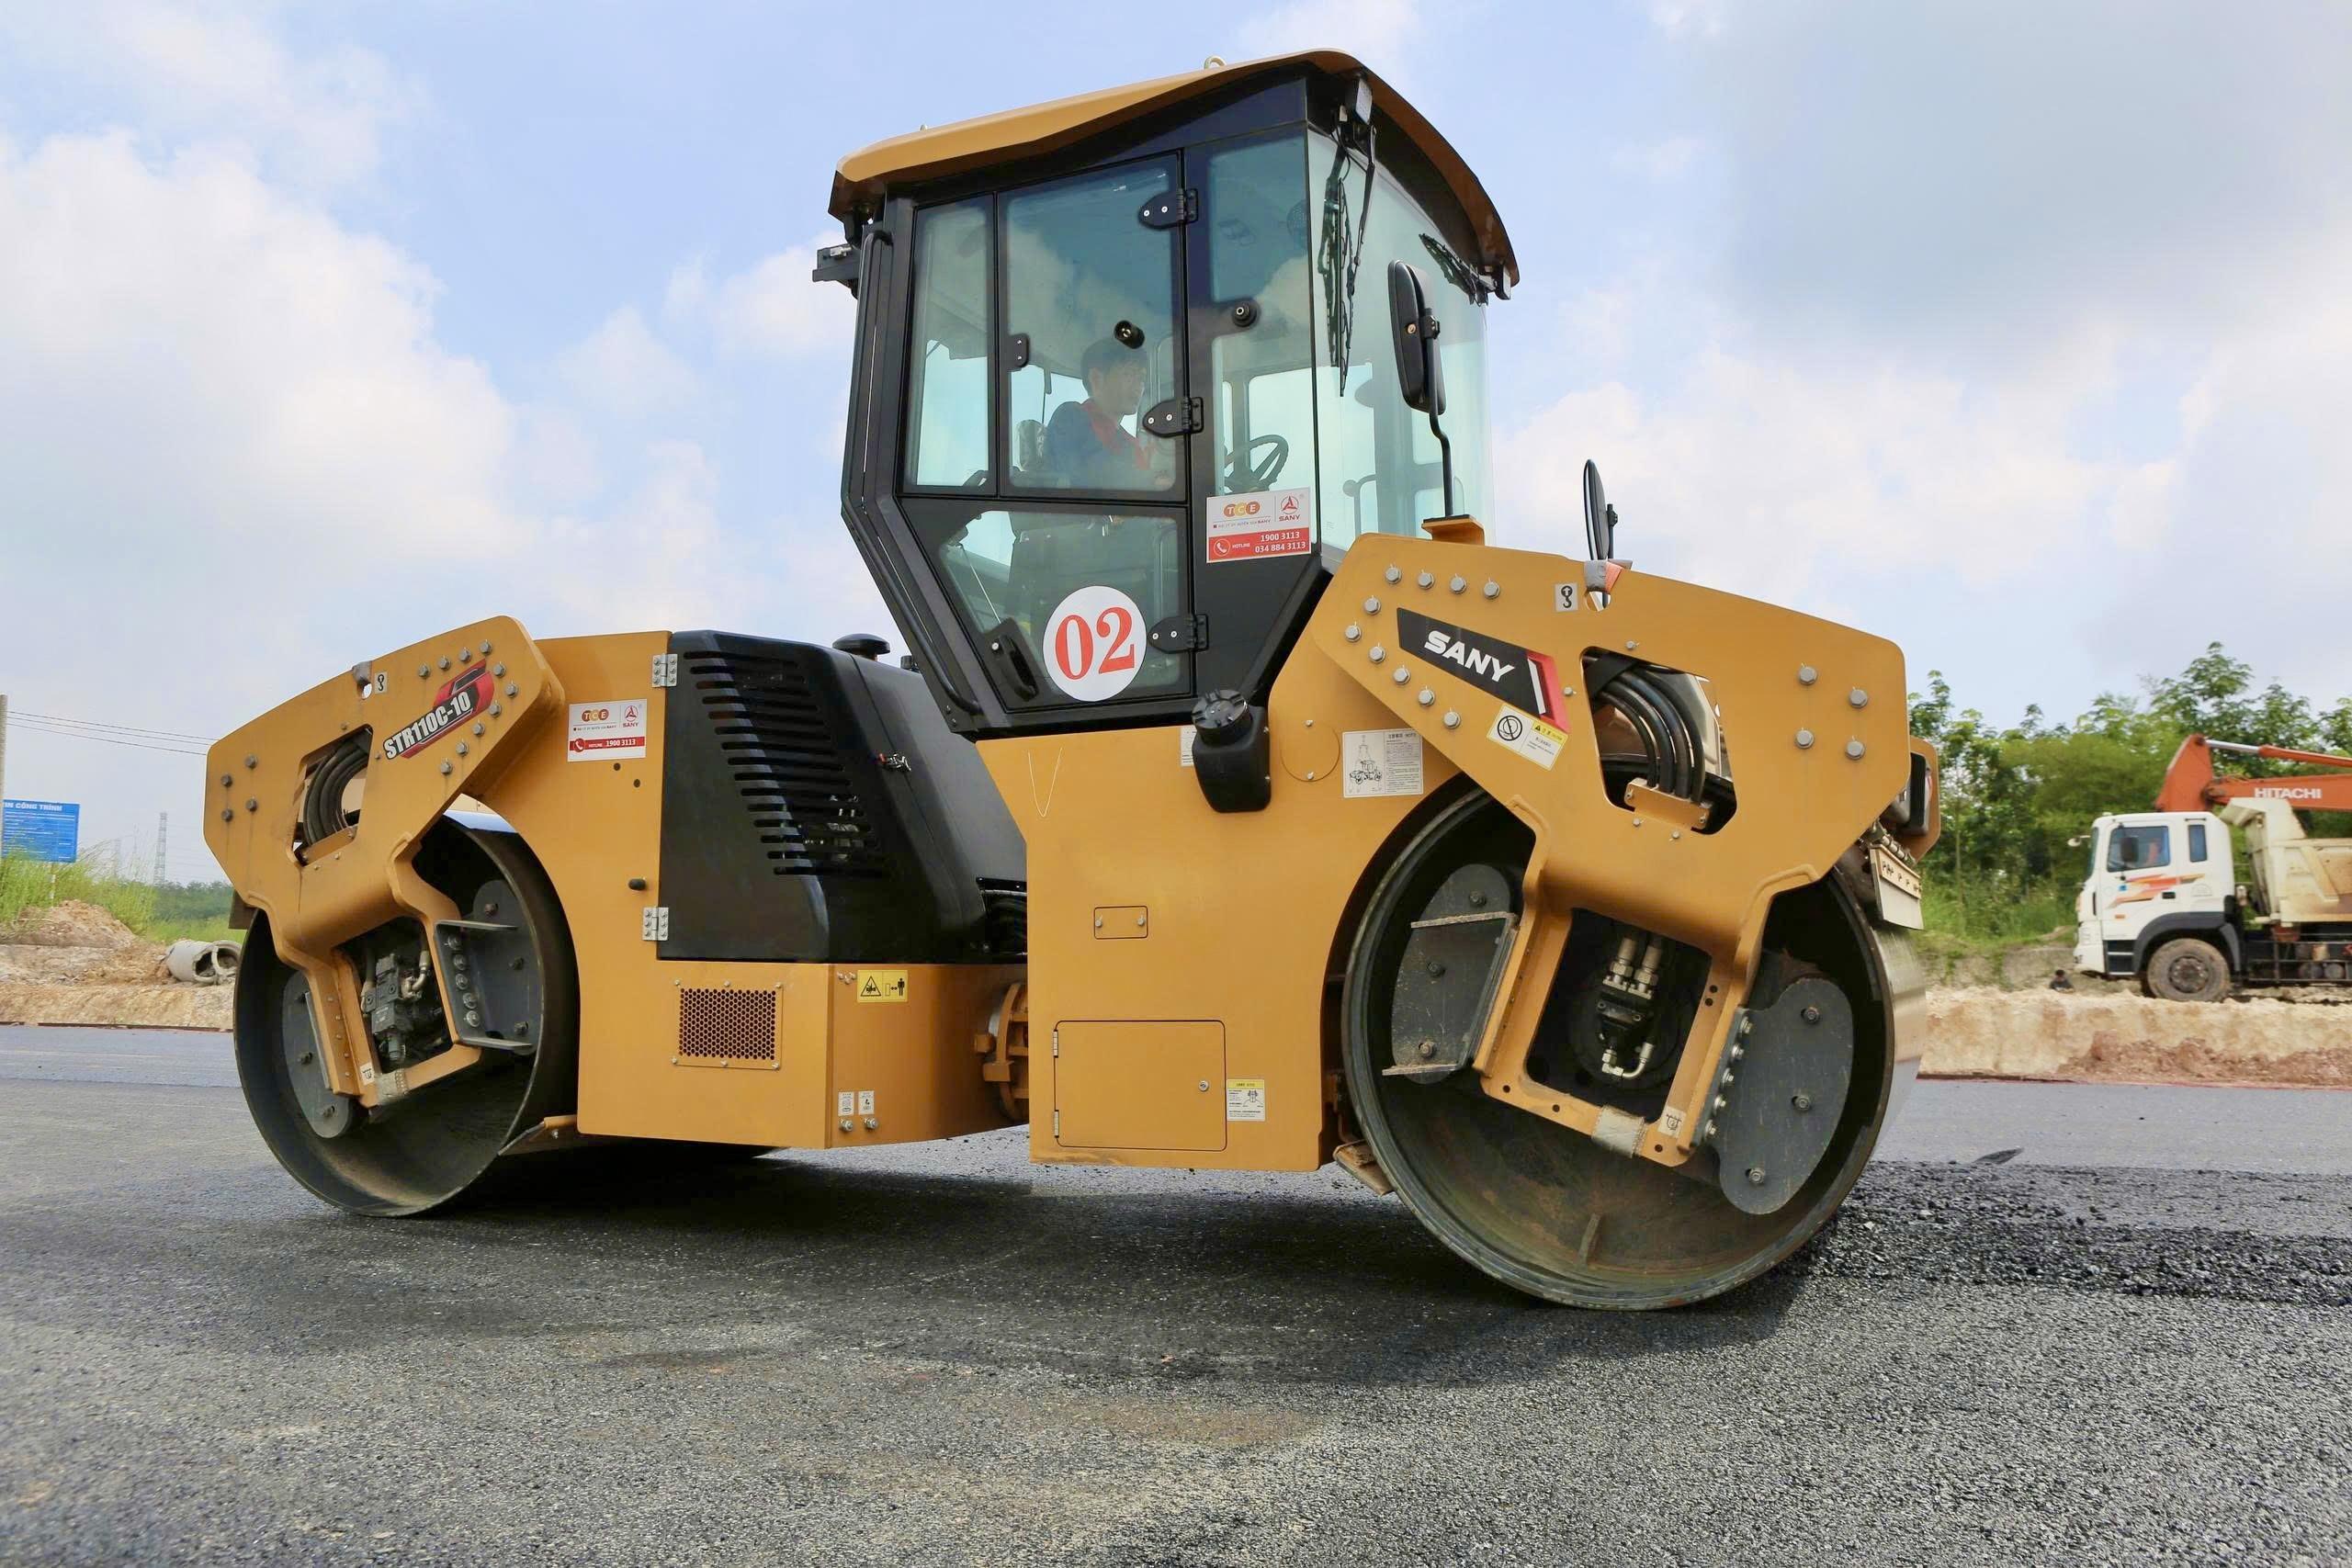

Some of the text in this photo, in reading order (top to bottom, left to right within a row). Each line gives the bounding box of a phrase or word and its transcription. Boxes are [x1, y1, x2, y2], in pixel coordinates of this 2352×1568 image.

[1226, 502, 1258, 515] TCE
[1278, 513, 1301, 522] SANY
[1261, 531, 1300, 542] 1900 3113
[1255, 541, 1306, 553] 034 884 3113
[1055, 606, 1136, 680] 02
[1424, 630, 1515, 682] SANY
[583, 710, 607, 720] TCE
[383, 690, 472, 760] STR110C-10
[2254, 787, 2323, 799] HITACHI
